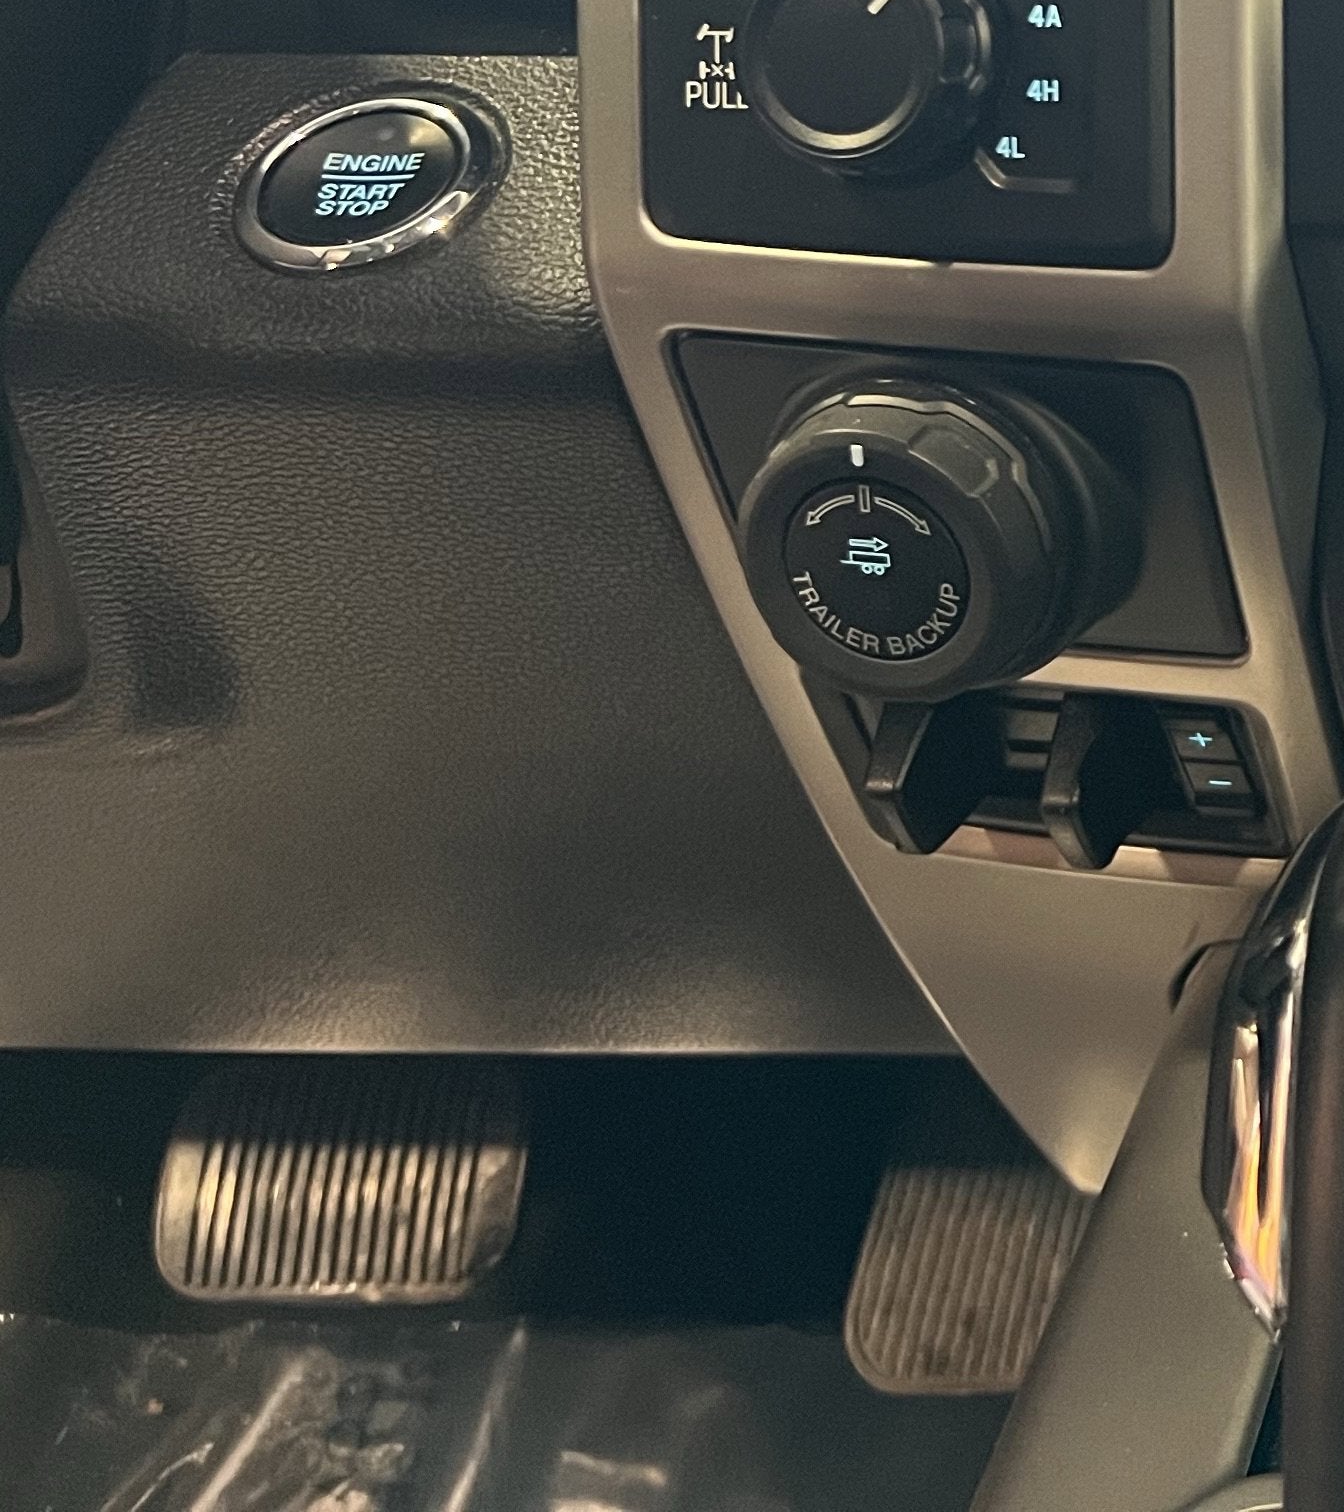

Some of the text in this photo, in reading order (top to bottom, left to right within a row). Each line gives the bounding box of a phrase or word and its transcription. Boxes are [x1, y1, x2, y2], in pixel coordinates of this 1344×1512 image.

[1027, 4, 1062, 28] 4A
[1026, 79, 1060, 102] 4H
[995, 136, 1026, 159] 4L
[322, 151, 425, 172] ENGINE
[317, 182, 404, 200] START
[314, 200, 389, 217] STOP
[792, 571, 961, 656] TRAILER BACKUP
